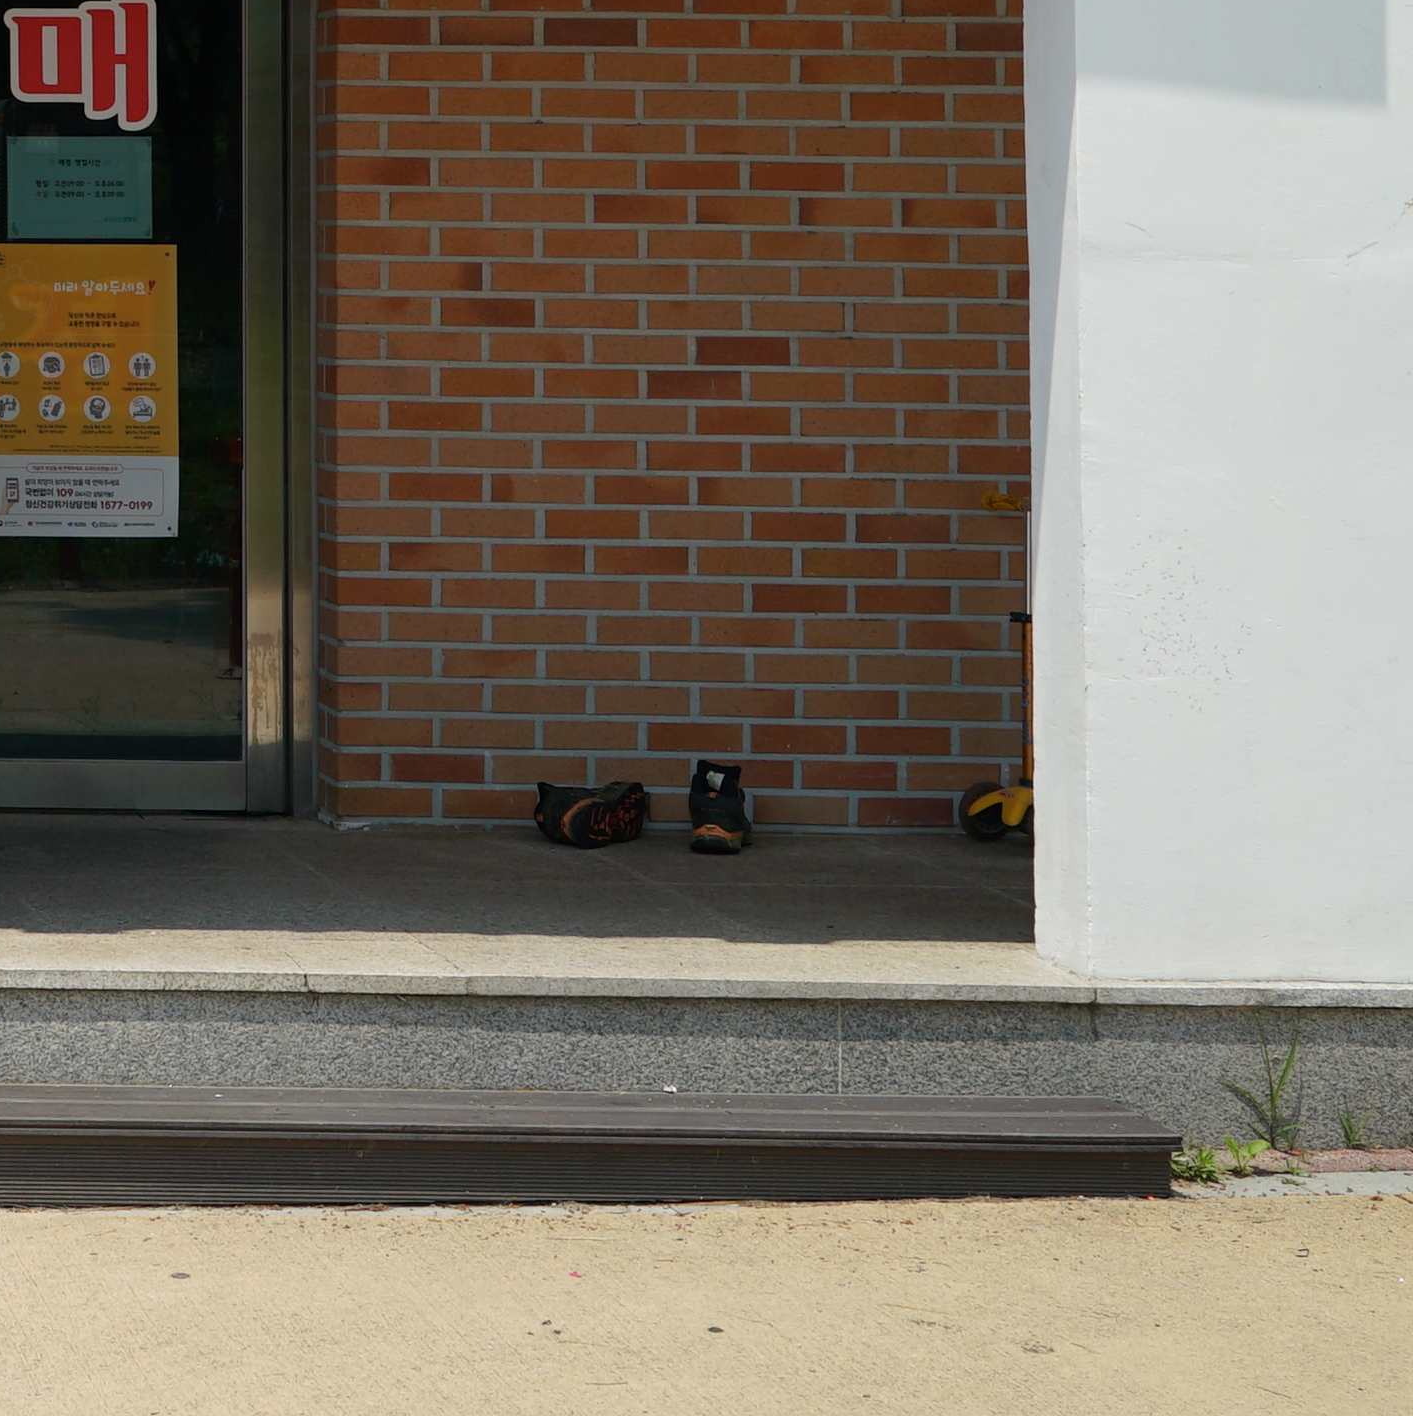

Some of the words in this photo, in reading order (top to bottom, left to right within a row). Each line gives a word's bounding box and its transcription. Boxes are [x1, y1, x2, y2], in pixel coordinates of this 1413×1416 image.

[54, 281, 78, 292] 미리
[56, 488, 74, 497] 109
[99, 500, 153, 510] 1577-0199
